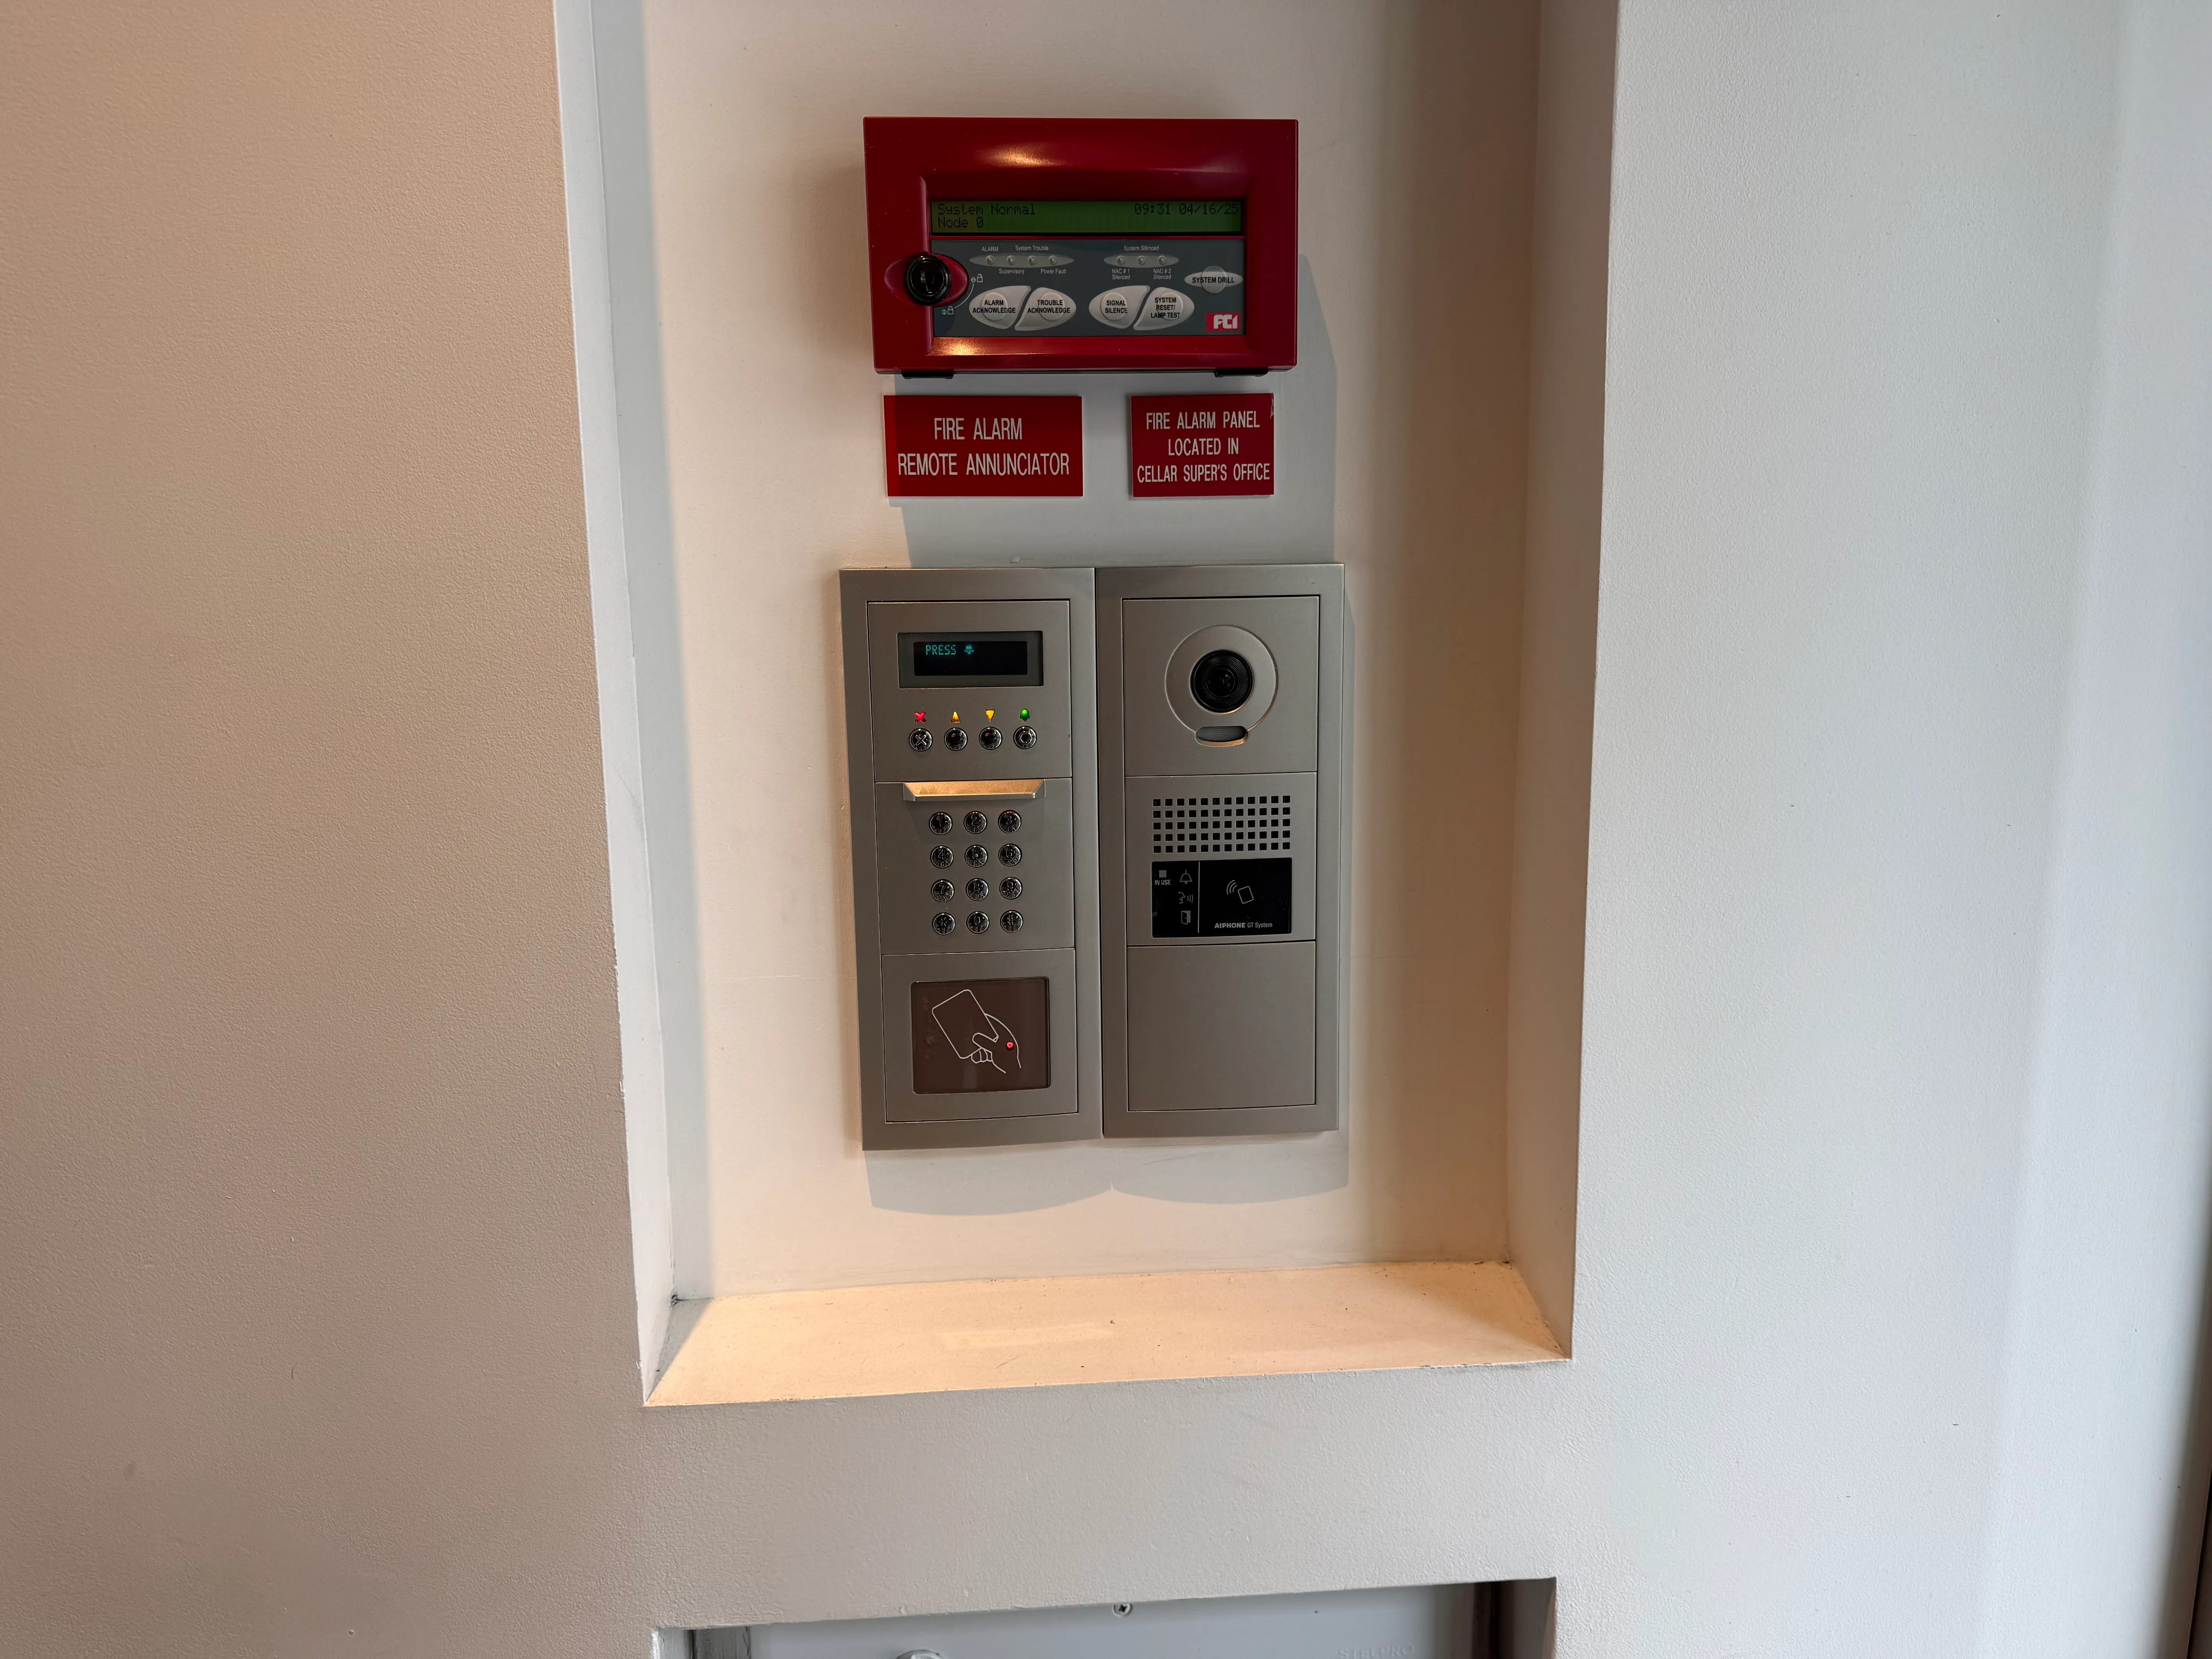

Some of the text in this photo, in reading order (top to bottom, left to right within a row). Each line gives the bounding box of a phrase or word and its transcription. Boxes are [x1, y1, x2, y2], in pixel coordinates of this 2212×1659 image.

[938, 203, 1035, 215] System Normal
[1134, 203, 1239, 215] 09:31 04/16/25
[938, 216, 984, 228] Node 0
[1146, 410, 1260, 429] FIRE ALARM PANEL
[934, 417, 1022, 440] FIRE ALARM
[1168, 437, 1239, 456] LOCATED IN
[898, 452, 1070, 476] REMOTE ANNUNCIATOR
[1137, 463, 1270, 483] CELLAR SUPER'S OFFICE
[926, 644, 956, 655] PRESS
[936, 816, 943, 827] 1
[971, 814, 980, 826] 2
[1006, 815, 1012, 825] 3
[938, 849, 946, 860] 4
[971, 849, 980, 859] 5
[1006, 848, 1013, 859] 6
[939, 883, 947, 894] 7
[974, 882, 980, 893] 8
[1007, 881, 1013, 891] 9
[974, 915, 981, 926] 0
